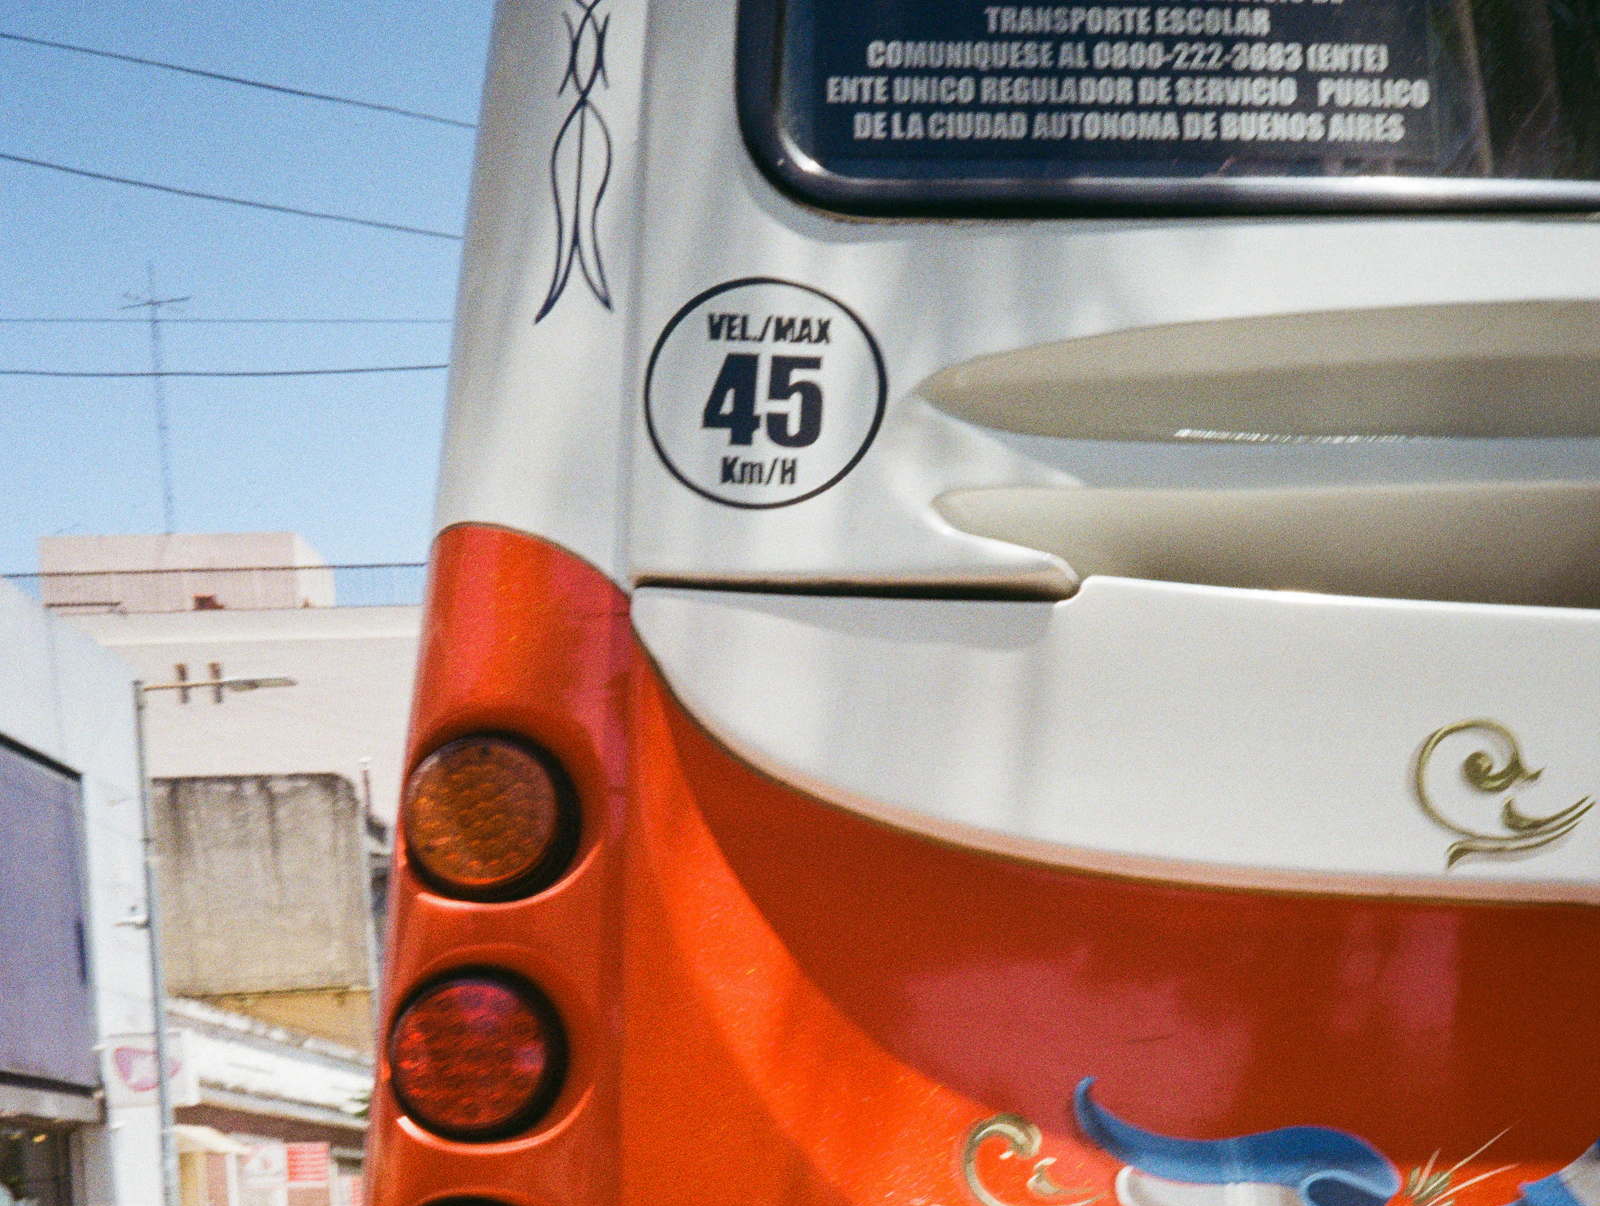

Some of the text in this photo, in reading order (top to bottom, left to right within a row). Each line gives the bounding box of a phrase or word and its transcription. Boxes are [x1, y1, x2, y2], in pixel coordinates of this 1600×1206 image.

[984, 6, 1271, 36] TRANSPORTE ESCOLAR
[866, 40, 1054, 71] COMUNIQUESE
[1057, 41, 1089, 70] AL
[1306, 43, 1389, 73] (ENTE)
[826, 75, 1430, 108] ENTE UNICO REGULADOR DE SERVICIO PUBLICO
[853, 111, 1405, 142] DE LA CIUDAD AUTONOMA DE BUENOS AIRES
[702, 353, 823, 448] 45
[719, 455, 797, 484] Km/H
